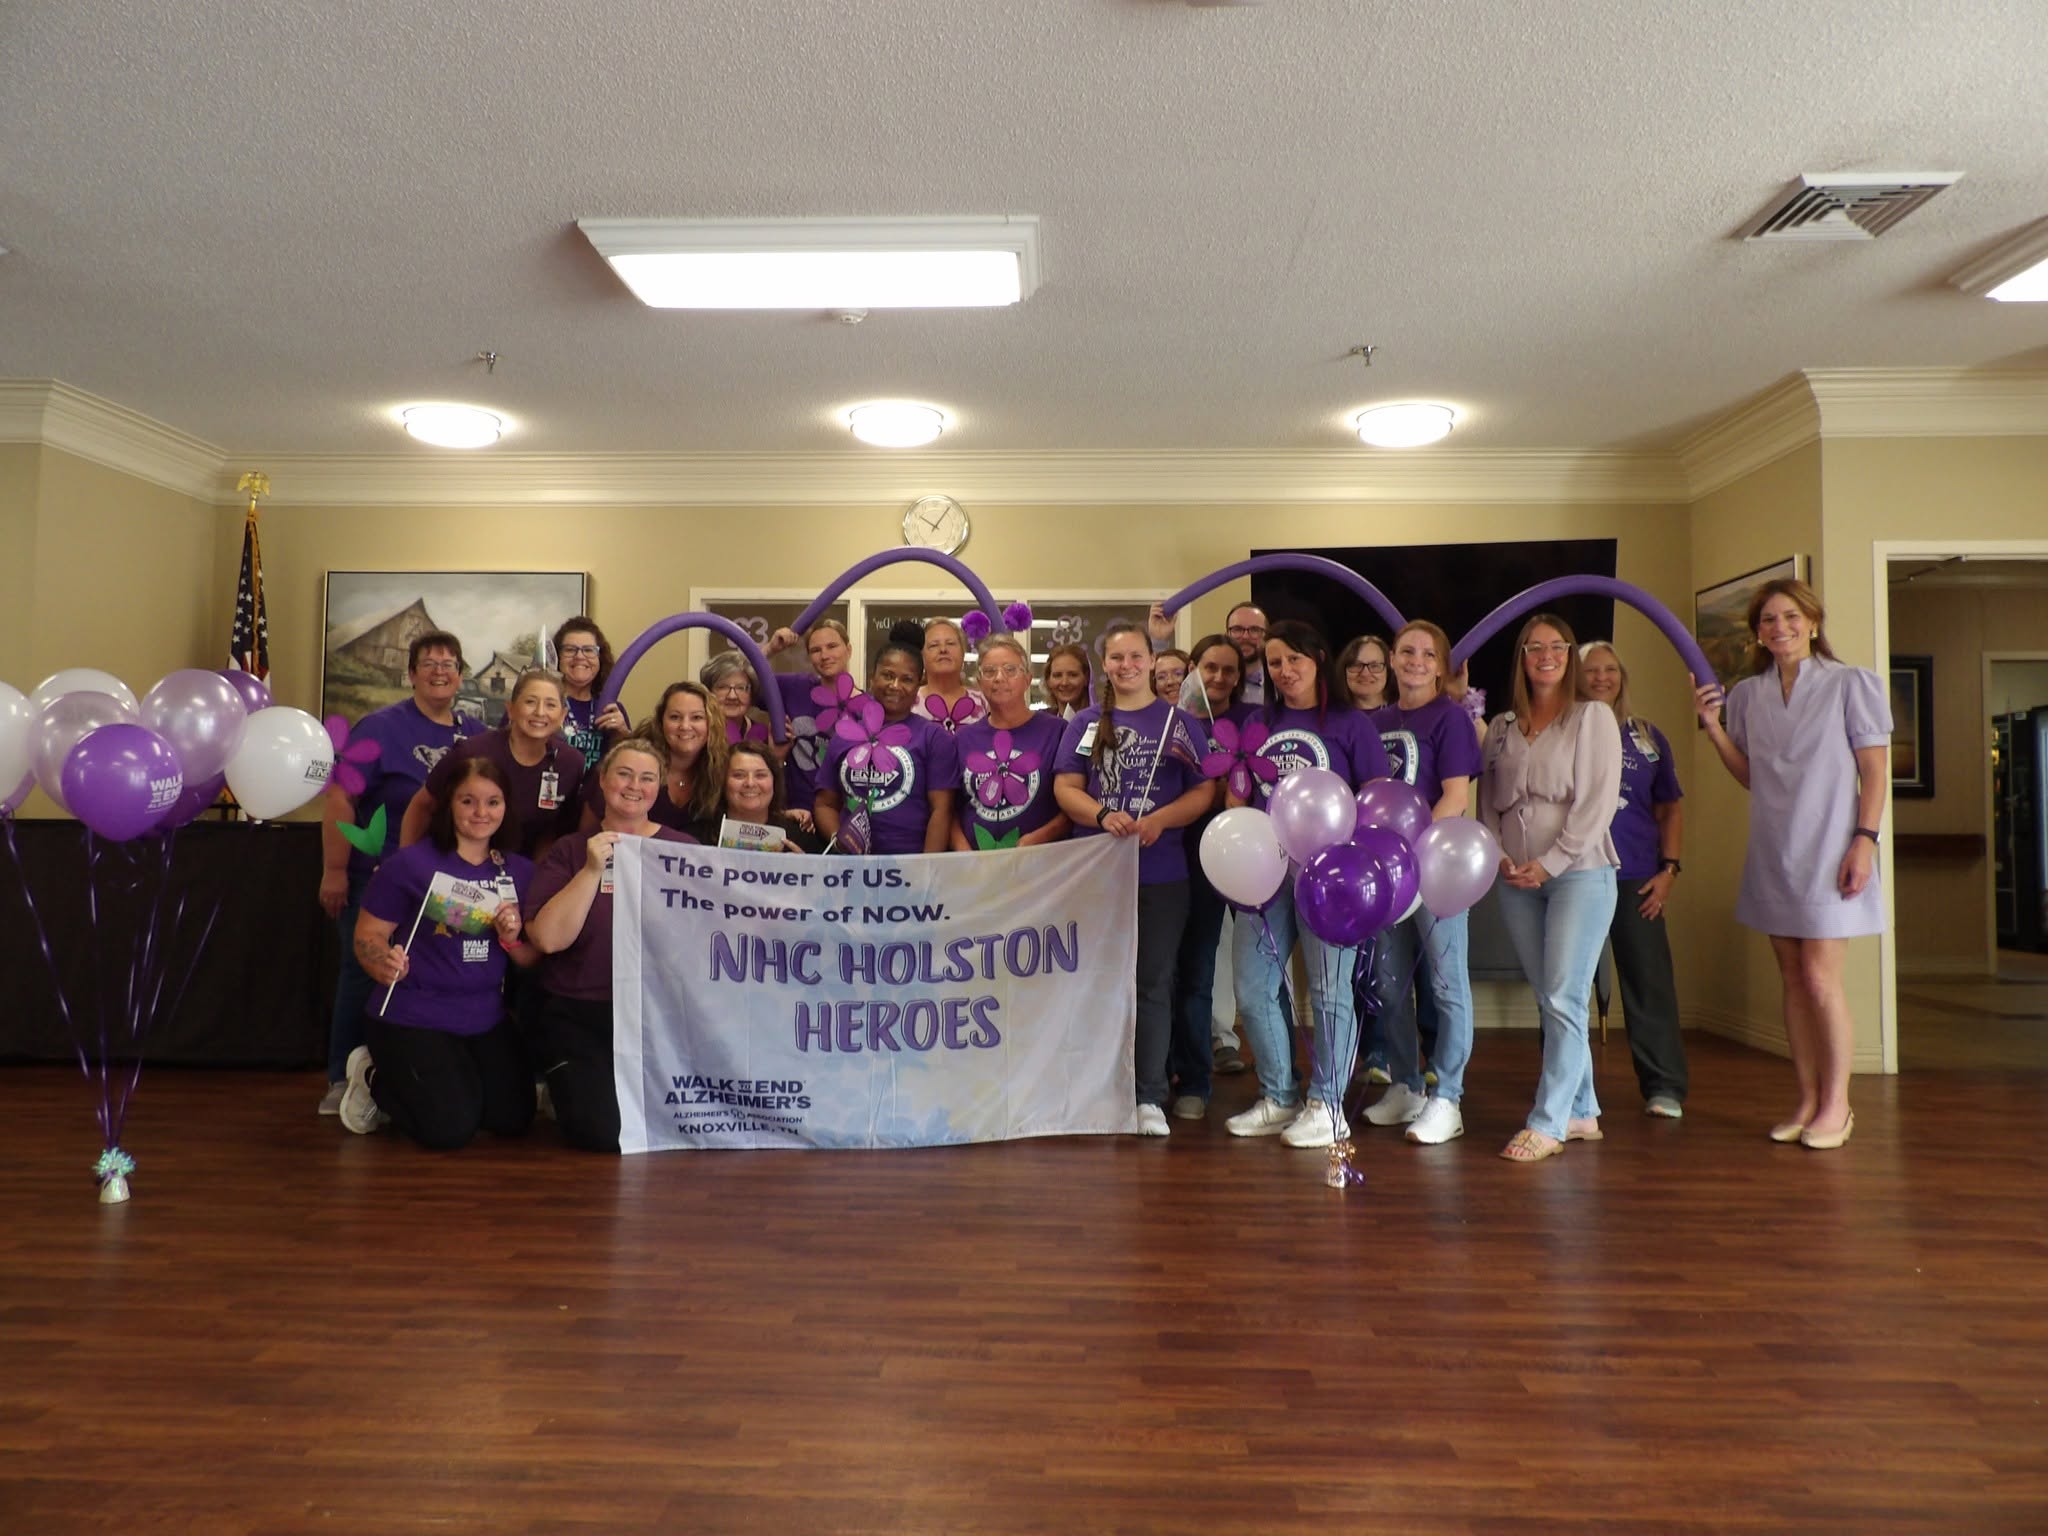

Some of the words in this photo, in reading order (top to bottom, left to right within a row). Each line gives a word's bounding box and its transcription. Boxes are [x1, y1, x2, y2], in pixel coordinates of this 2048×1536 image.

[658, 855, 714, 879] The
[723, 867, 814, 887] power
[823, 869, 853, 888] of
[862, 869, 912, 888] US.
[660, 888, 714, 911] The
[723, 903, 813, 923] power
[822, 906, 853, 923] of
[862, 903, 951, 924] NOW.
[709, 930, 823, 985] NHC
[838, 920, 1079, 986] HOLSTON
[794, 995, 1001, 1053] HEROES
[664, 1090, 812, 1110] ALZHEIMER'S
[672, 1075, 735, 1092] WALK
[755, 1080, 804, 1094] END
[673, 1110, 729, 1119] ALZHEIMER'S
[746, 1112, 804, 1124] ASSOCIATION
